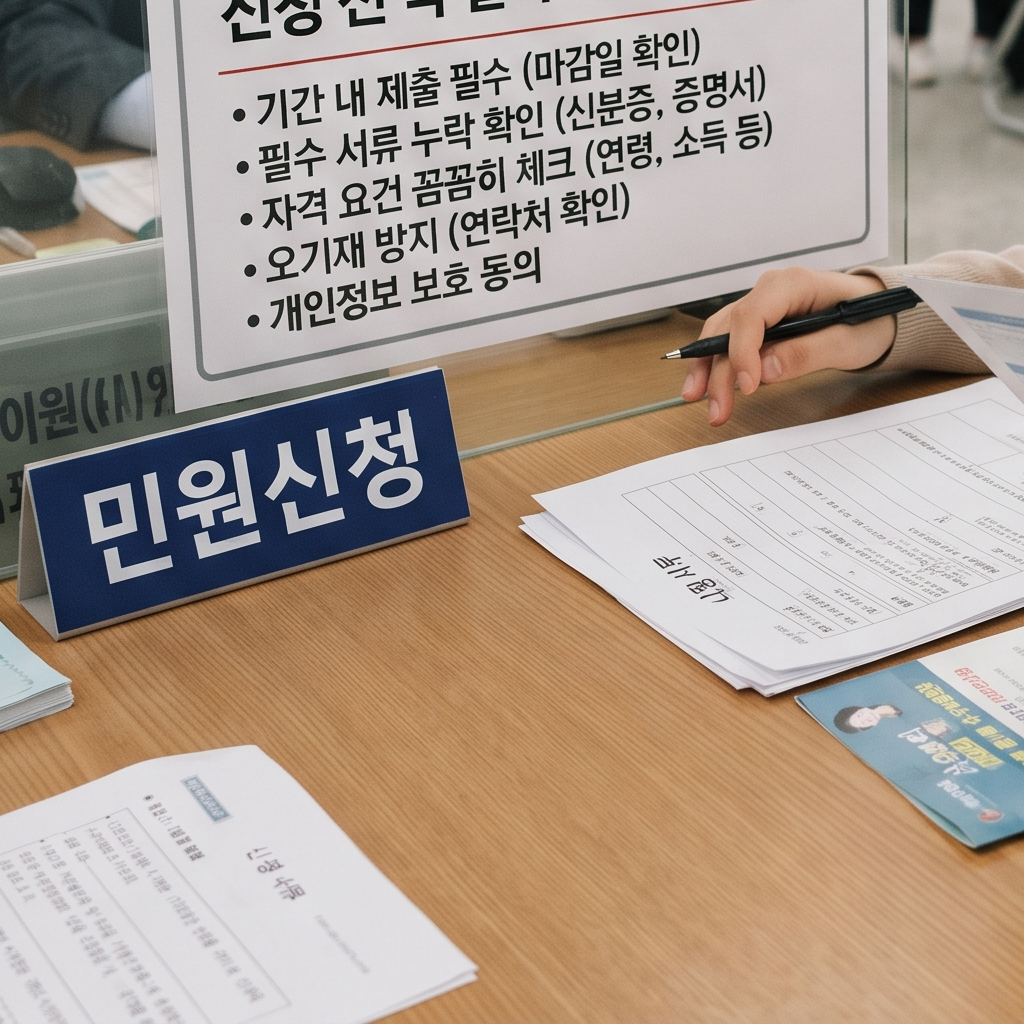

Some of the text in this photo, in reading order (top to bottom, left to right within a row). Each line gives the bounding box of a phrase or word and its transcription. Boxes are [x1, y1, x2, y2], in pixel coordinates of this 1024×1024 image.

[257, 28, 700, 129] 기간 내 제출 필수 (마감일 확인)
[258, 64, 766, 183] 필수 서류 누락 확인 (신분증, 증명서)
[262, 110, 773, 231] 자격 요건 꼼꼼히 체크 (연령, 소득 등)
[266, 182, 630, 282] 오기재 방지 (연락처 확인)
[270, 246, 541, 331] 개인정보 보호 동의
[83, 408, 424, 585] 민원신청
